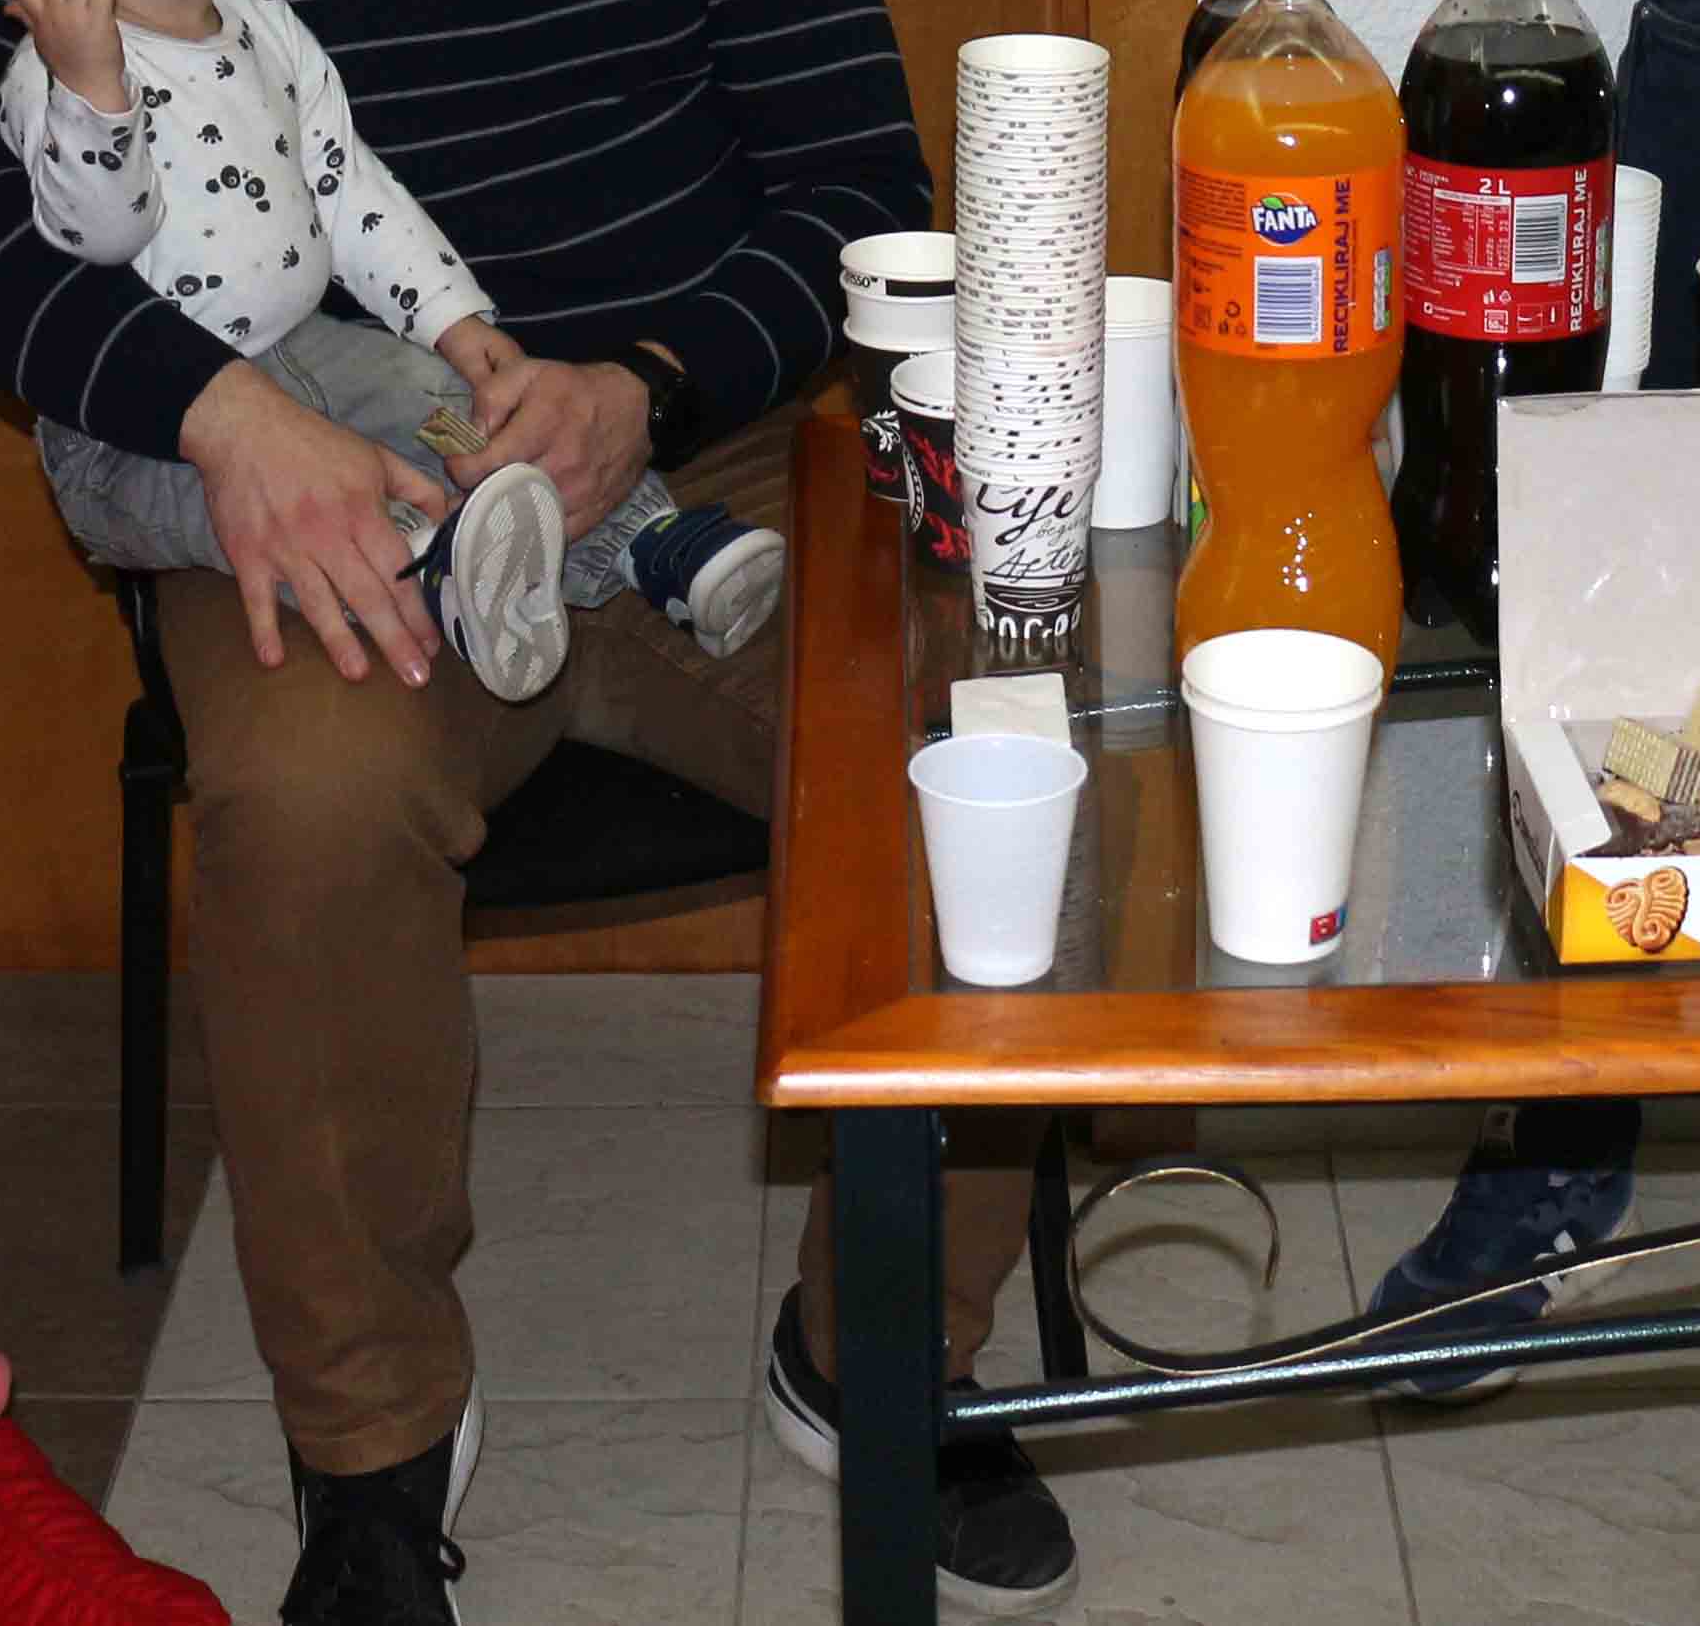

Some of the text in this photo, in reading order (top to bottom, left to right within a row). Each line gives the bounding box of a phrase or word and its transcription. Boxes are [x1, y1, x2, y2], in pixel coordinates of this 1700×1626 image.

[1479, 177, 1511, 195] 2 L
[1573, 168, 1588, 203] ME
[1251, 204, 1318, 234] FANTA
[1333, 177, 1351, 354] RECIKLIRAJ ME
[1569, 208, 1587, 332] RECIKLIRAJ
